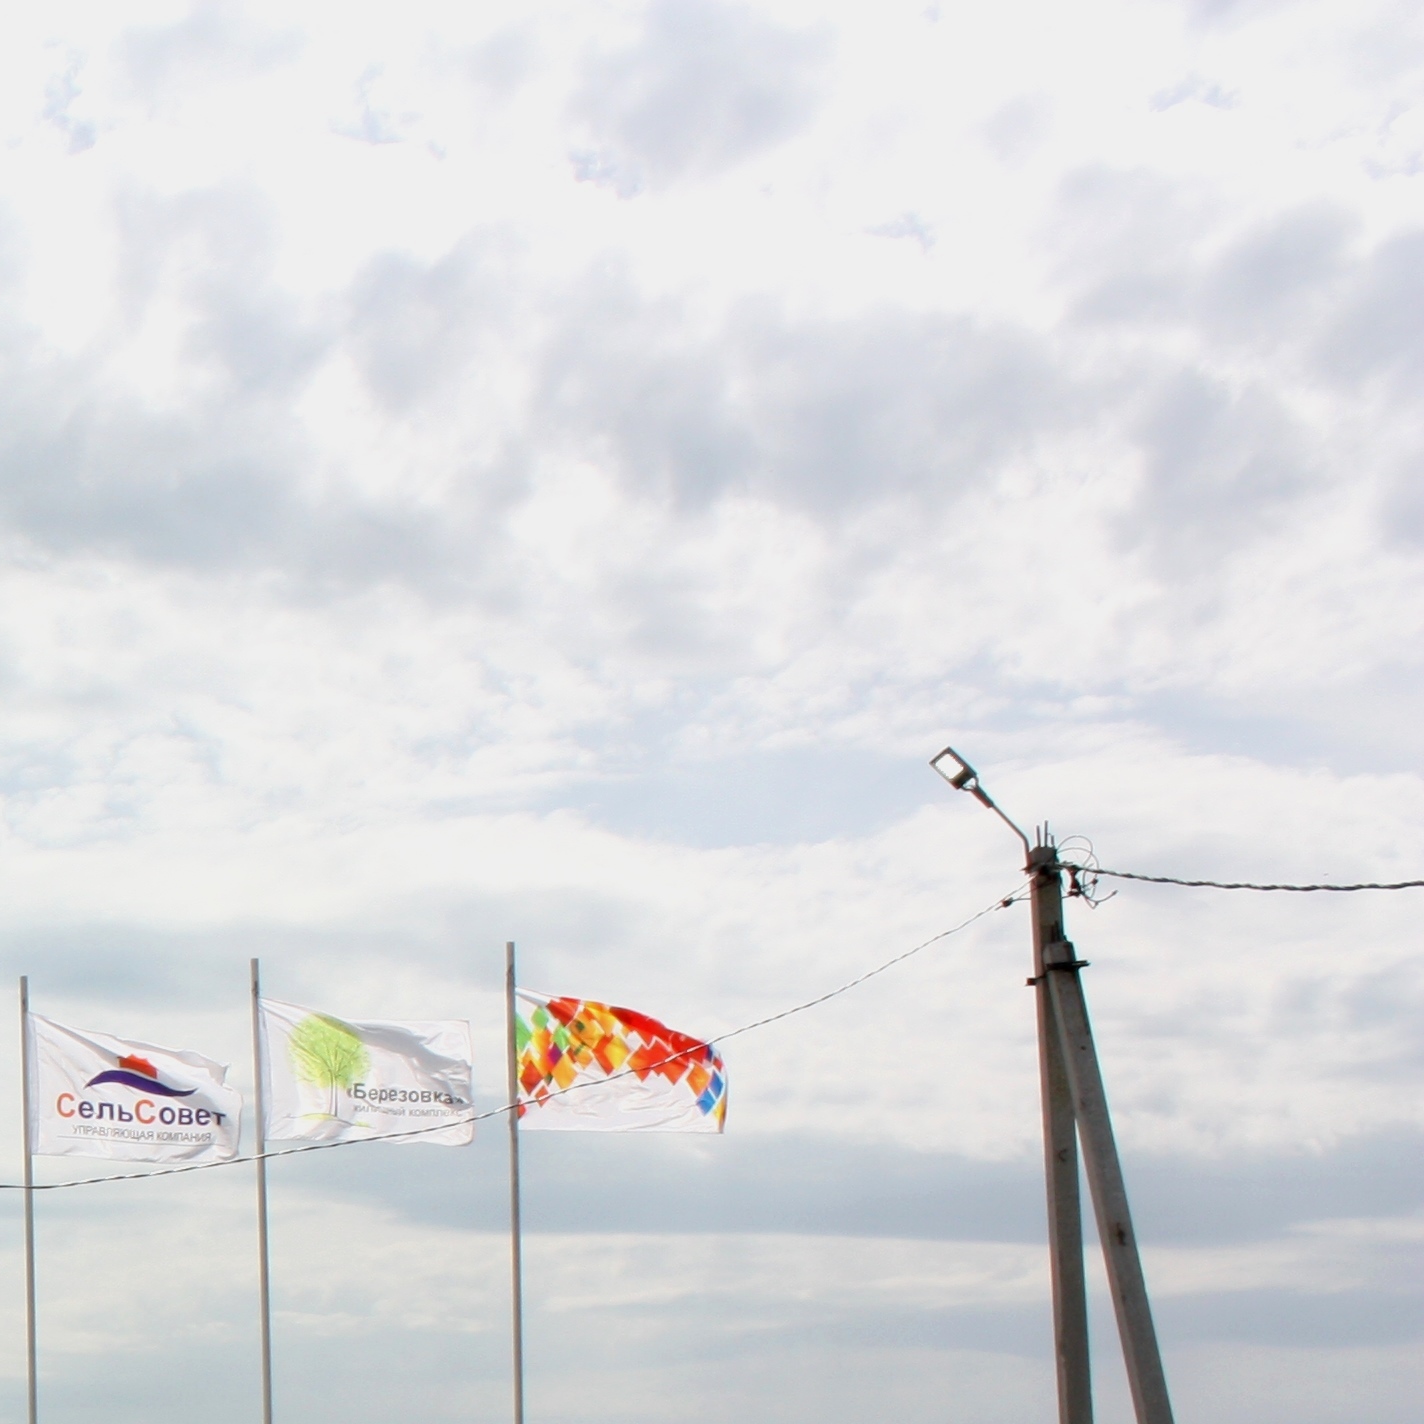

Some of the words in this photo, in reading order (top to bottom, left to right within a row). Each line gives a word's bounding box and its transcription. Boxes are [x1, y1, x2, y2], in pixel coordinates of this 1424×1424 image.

[57, 1093, 226, 1127] СельСовет
[72, 1124, 154, 1141] УПРАВЛЯЮЩАЯ
[156, 1131, 212, 1143] КОМПАНИЯ
